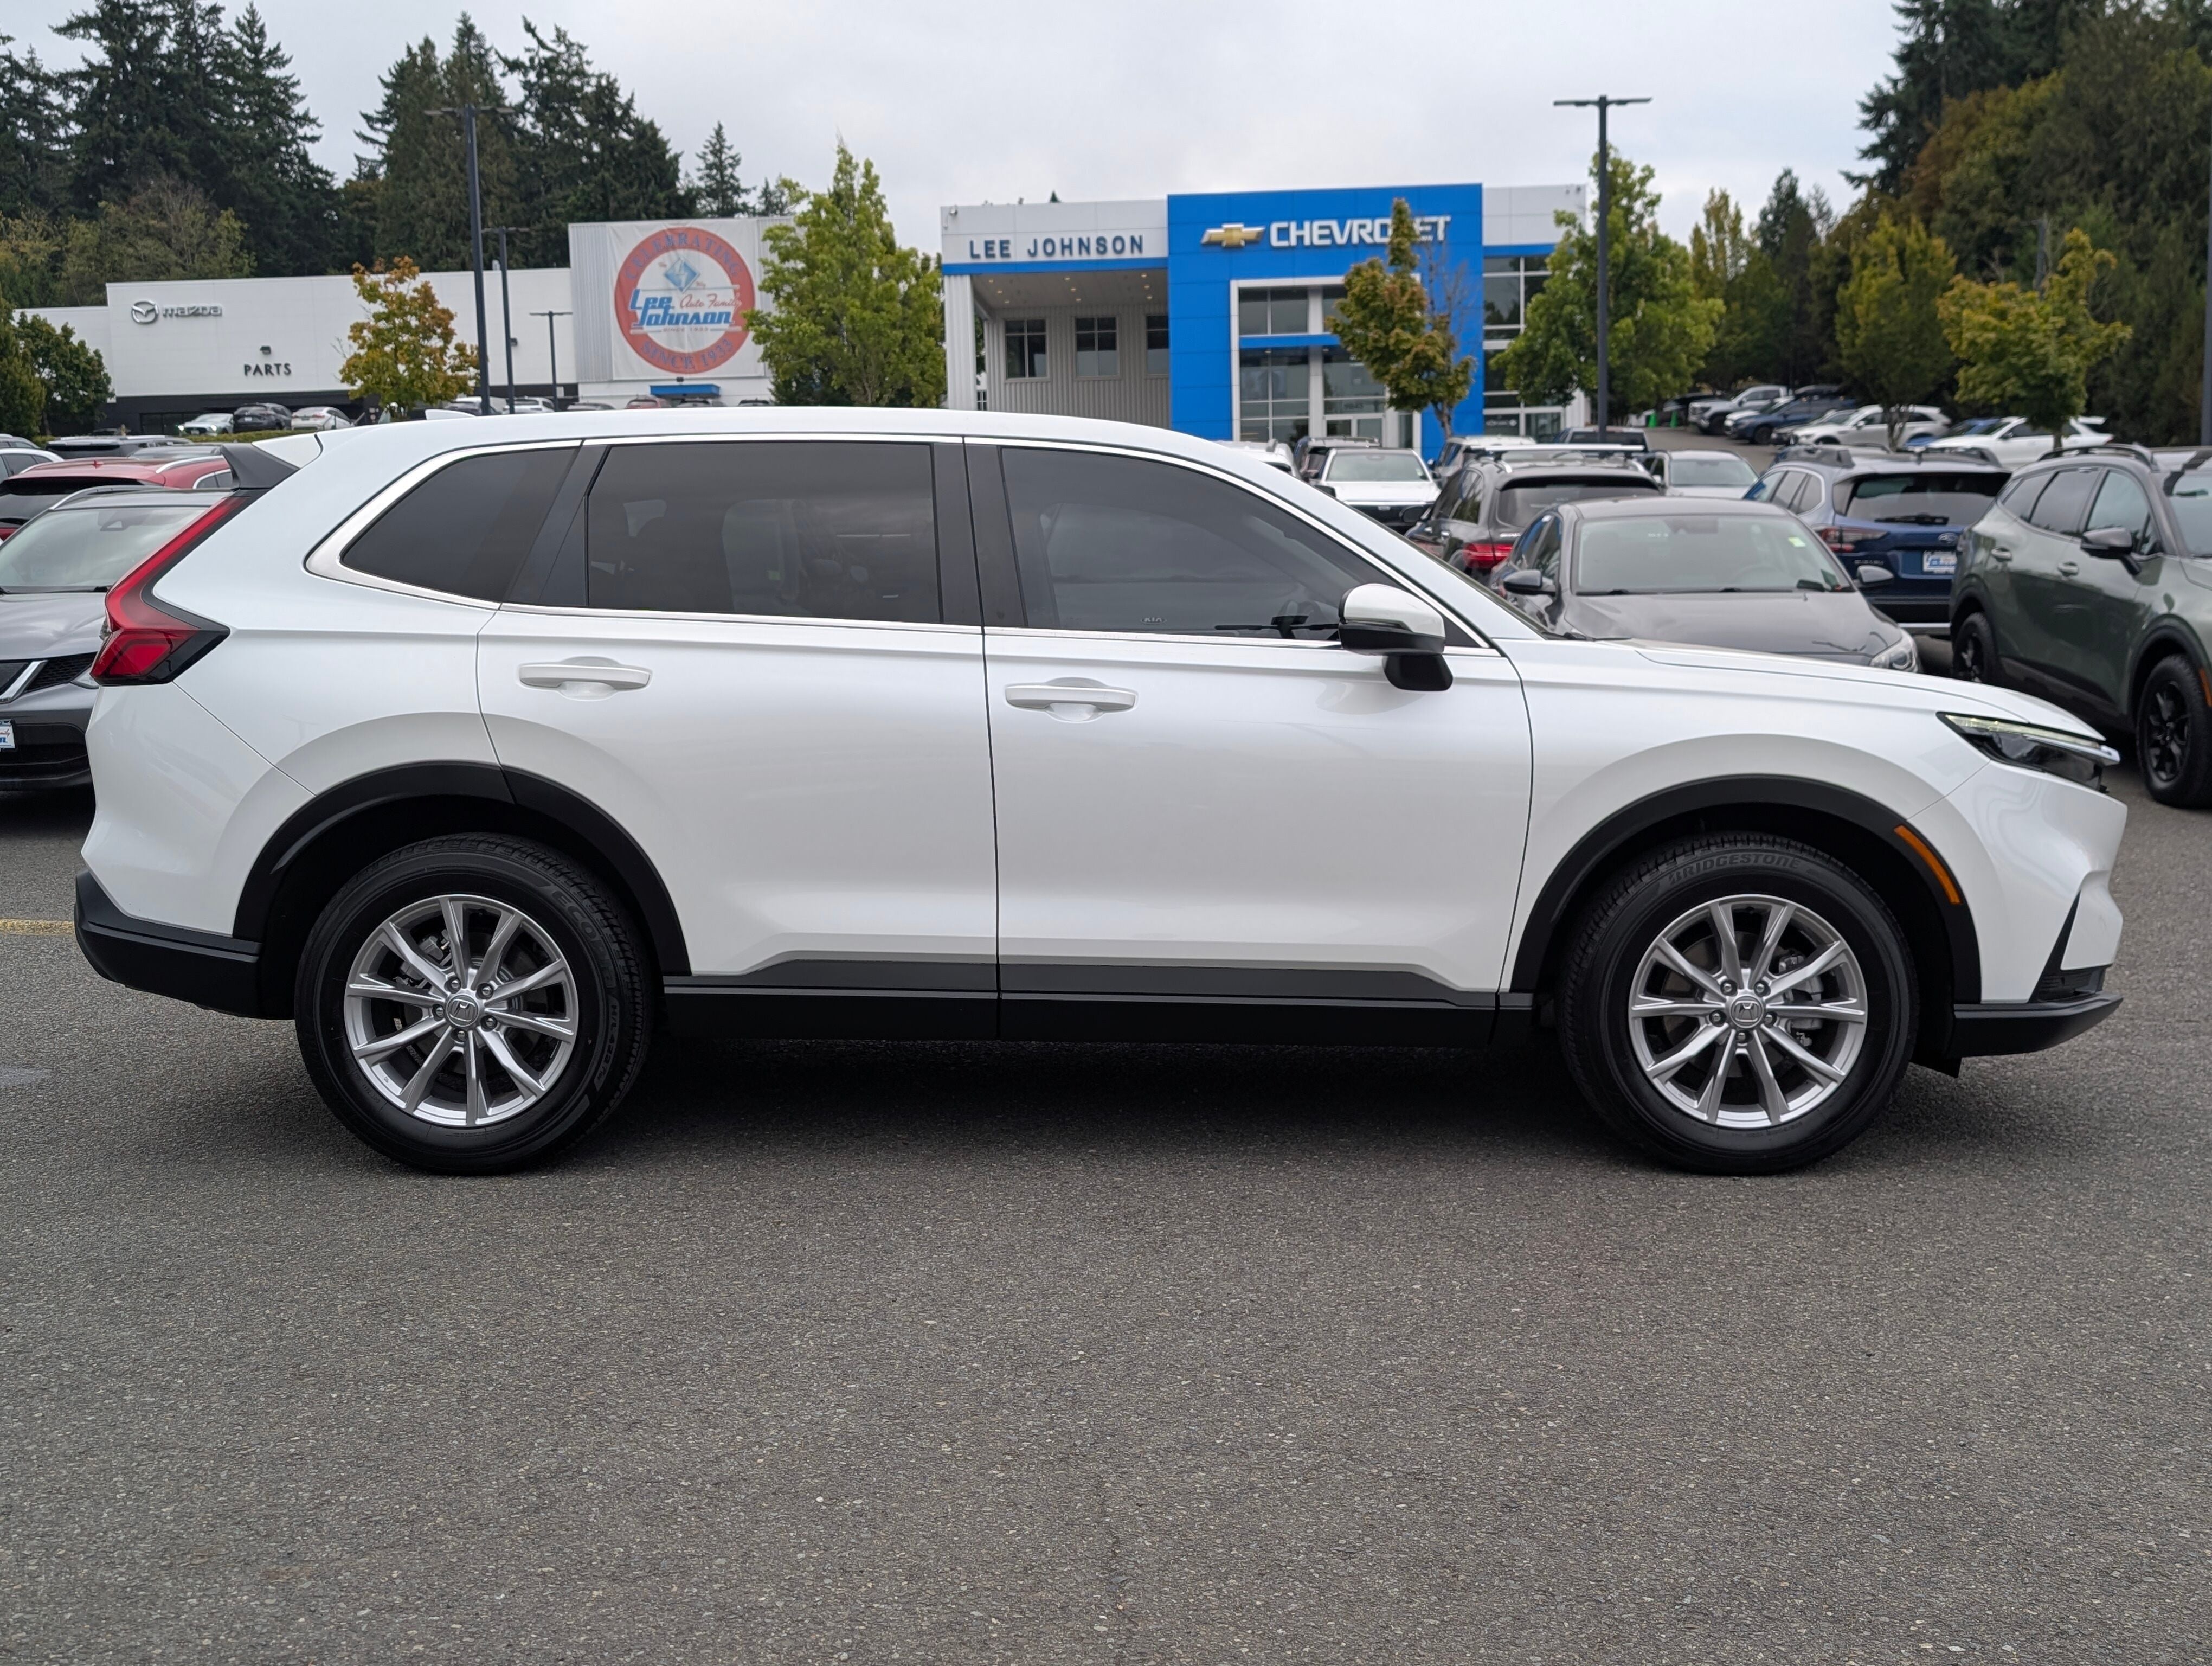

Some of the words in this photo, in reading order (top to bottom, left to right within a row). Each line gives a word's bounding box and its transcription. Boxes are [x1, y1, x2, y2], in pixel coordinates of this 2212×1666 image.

[1270, 215, 1451, 247] CHEVROET
[626, 232, 742, 279] CELEBRATING
[969, 239, 1011, 259] LEE
[1027, 235, 1143, 257] JOHNSON
[629, 289, 676, 310] Lee
[680, 294, 704, 308] Auto
[706, 292, 742, 311] Family
[633, 306, 735, 327] Johnson
[641, 342, 696, 370] SINCE
[700, 337, 732, 367] 1933
[243, 363, 292, 376] PARTS
[1668, 854, 1801, 886] BRIDGESTONE
